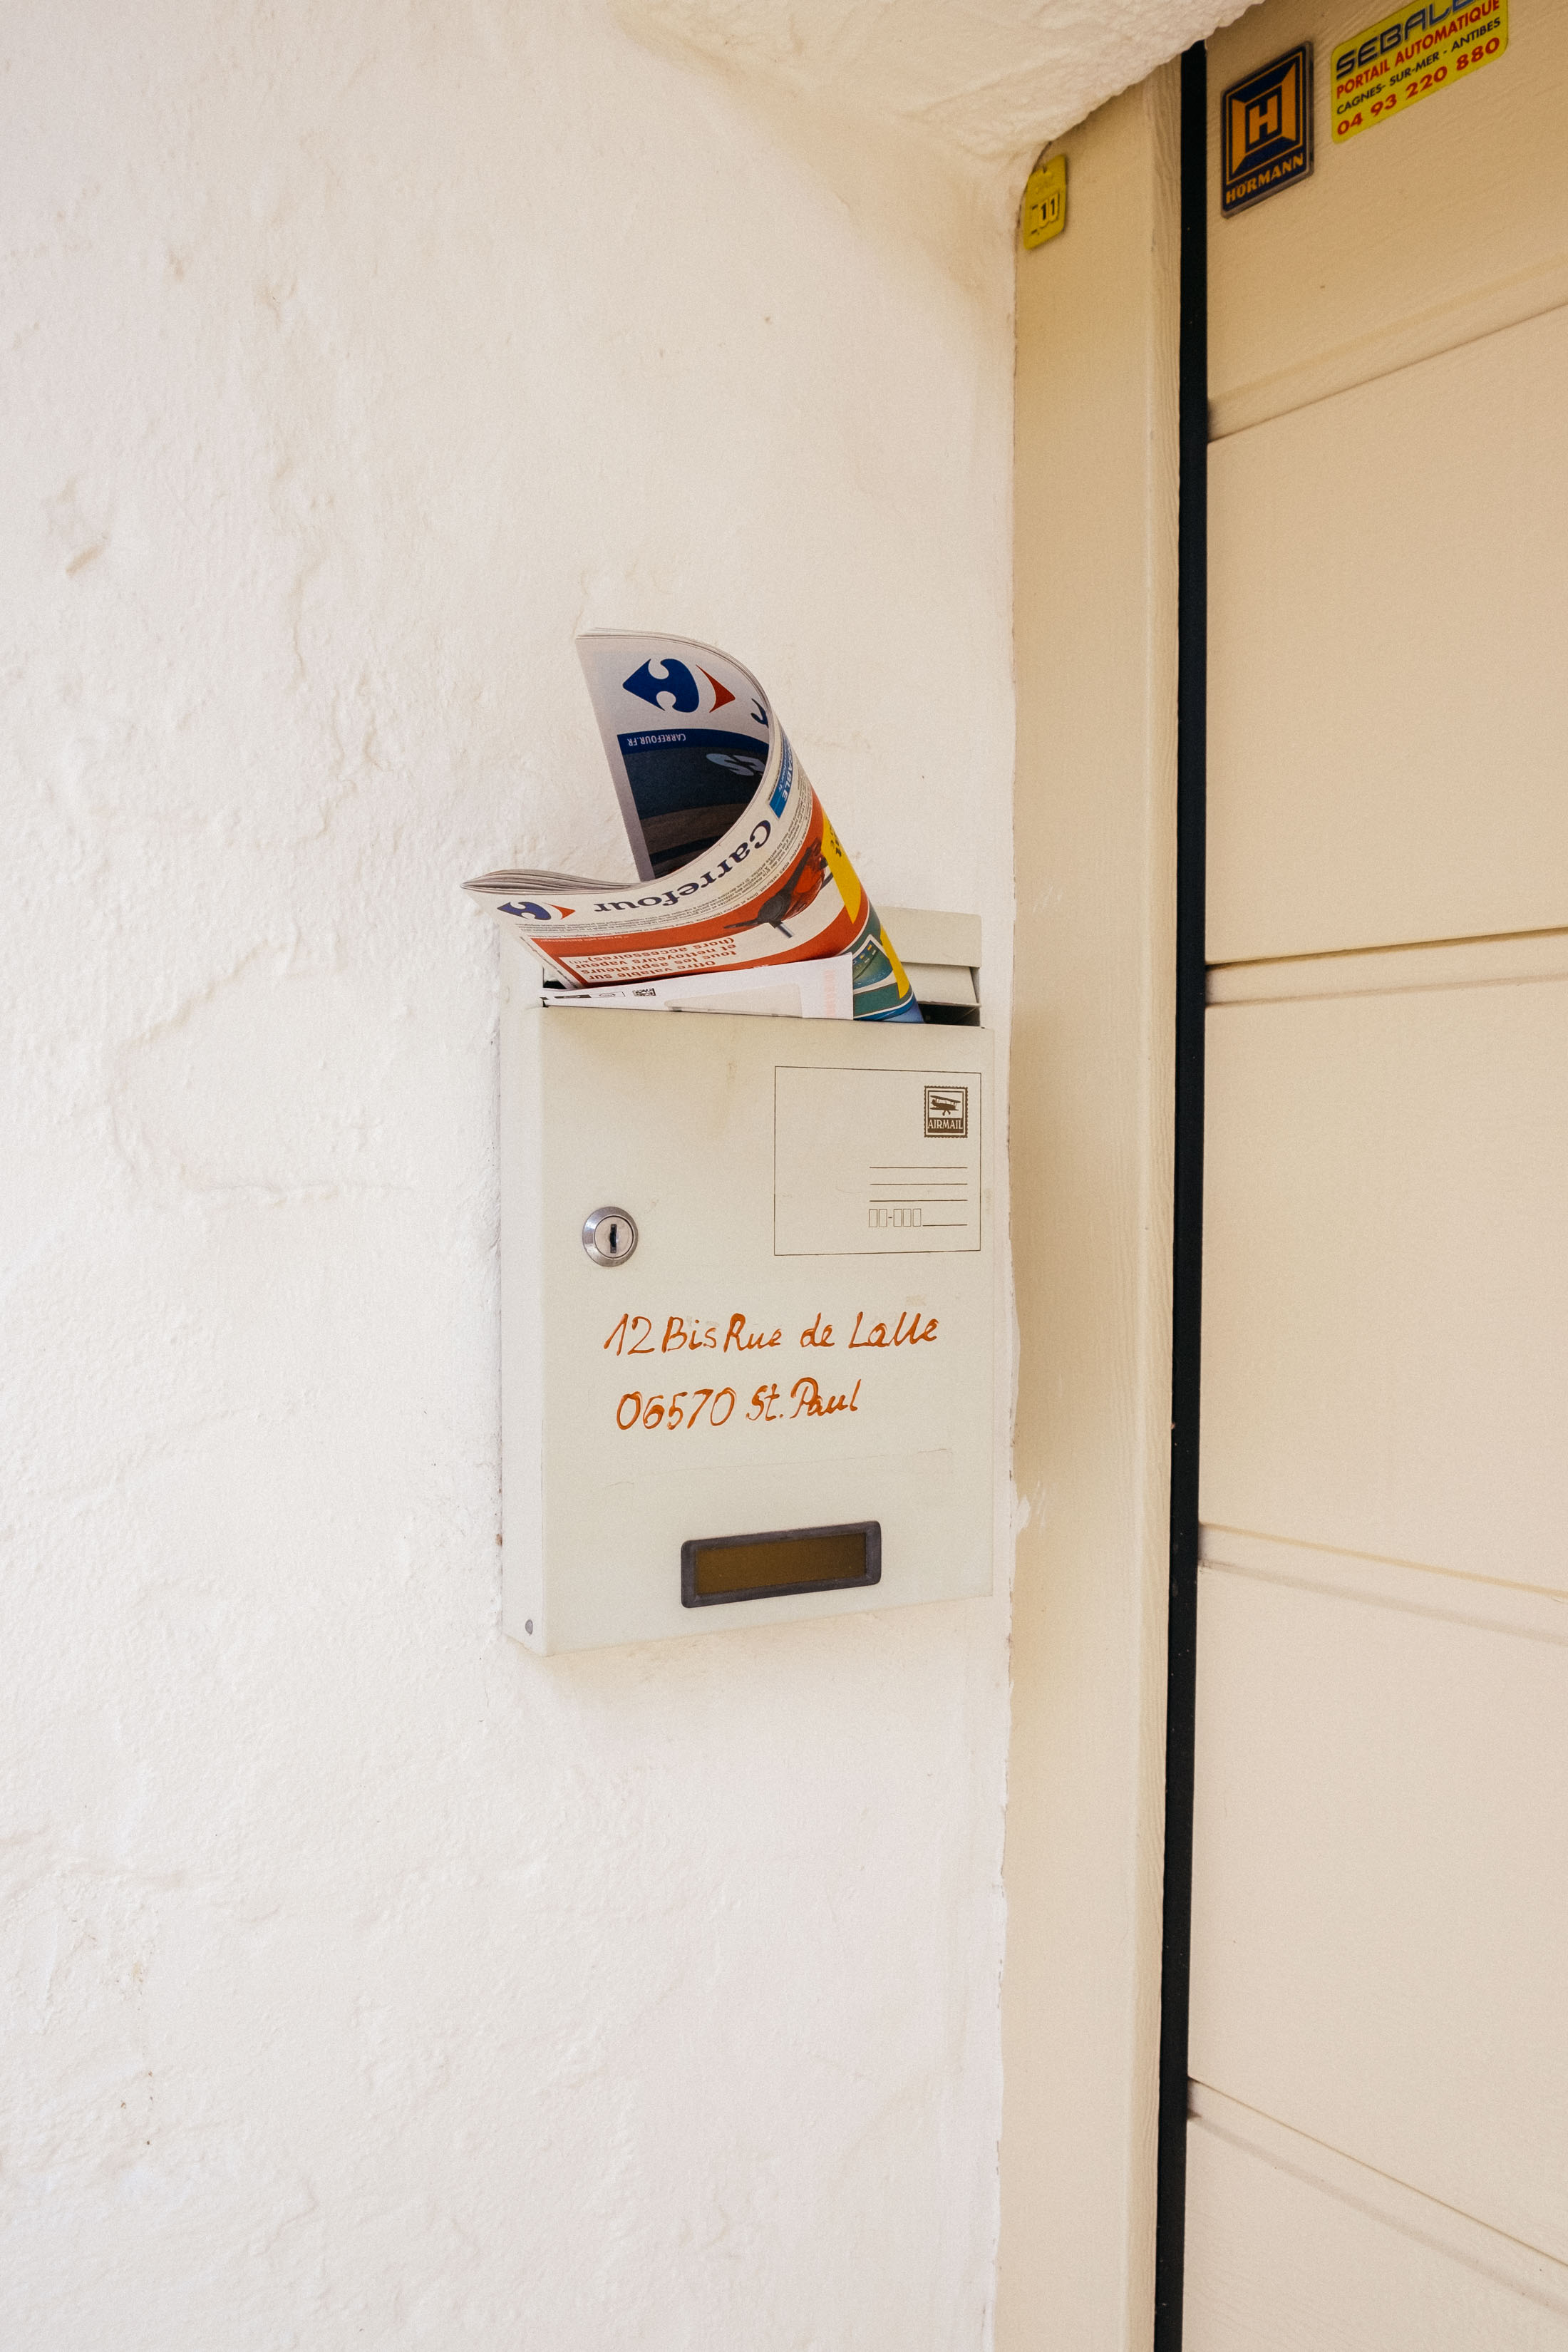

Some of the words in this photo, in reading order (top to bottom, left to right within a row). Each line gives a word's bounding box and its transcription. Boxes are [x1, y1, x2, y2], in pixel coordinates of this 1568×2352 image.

[1337, 59, 1390, 99] PORTAIL
[1395, 0, 1500, 66] AUTOMATIQUE
[1390, 52, 1439, 86] SUR-MER
[1451, 17, 1500, 51] ANTIBES
[1337, 112, 1363, 135] 04
[1371, 94, 1397, 117] 93
[1405, 66, 1448, 100] 220
[1456, 38, 1500, 71] 880
[1249, 95, 1278, 144] H
[627, 733, 686, 746] CARREFOUR.FR
[594, 820, 771, 912] Carrefour
[692, 937, 734, 949] (hors
[632, 948, 716, 964] nettoyeurs
[703, 951, 736, 959] tous
[575, 960, 627, 969] vapeur
[581, 962, 669, 974] aspirateurs
[678, 961, 716, 969] Offre
[617, 967, 672, 978] valable
[928, 1118, 963, 1130] AIRMAIL
[603, 1313, 654, 1355] 12
[661, 1316, 718, 1353] Bis
[723, 1313, 783, 1353] Rue
[800, 1311, 835, 1347] de
[848, 1311, 939, 1349] Lalle
[617, 1387, 736, 1430] 06570
[746, 1383, 784, 1422] St.
[789, 1377, 862, 1419] Paul
